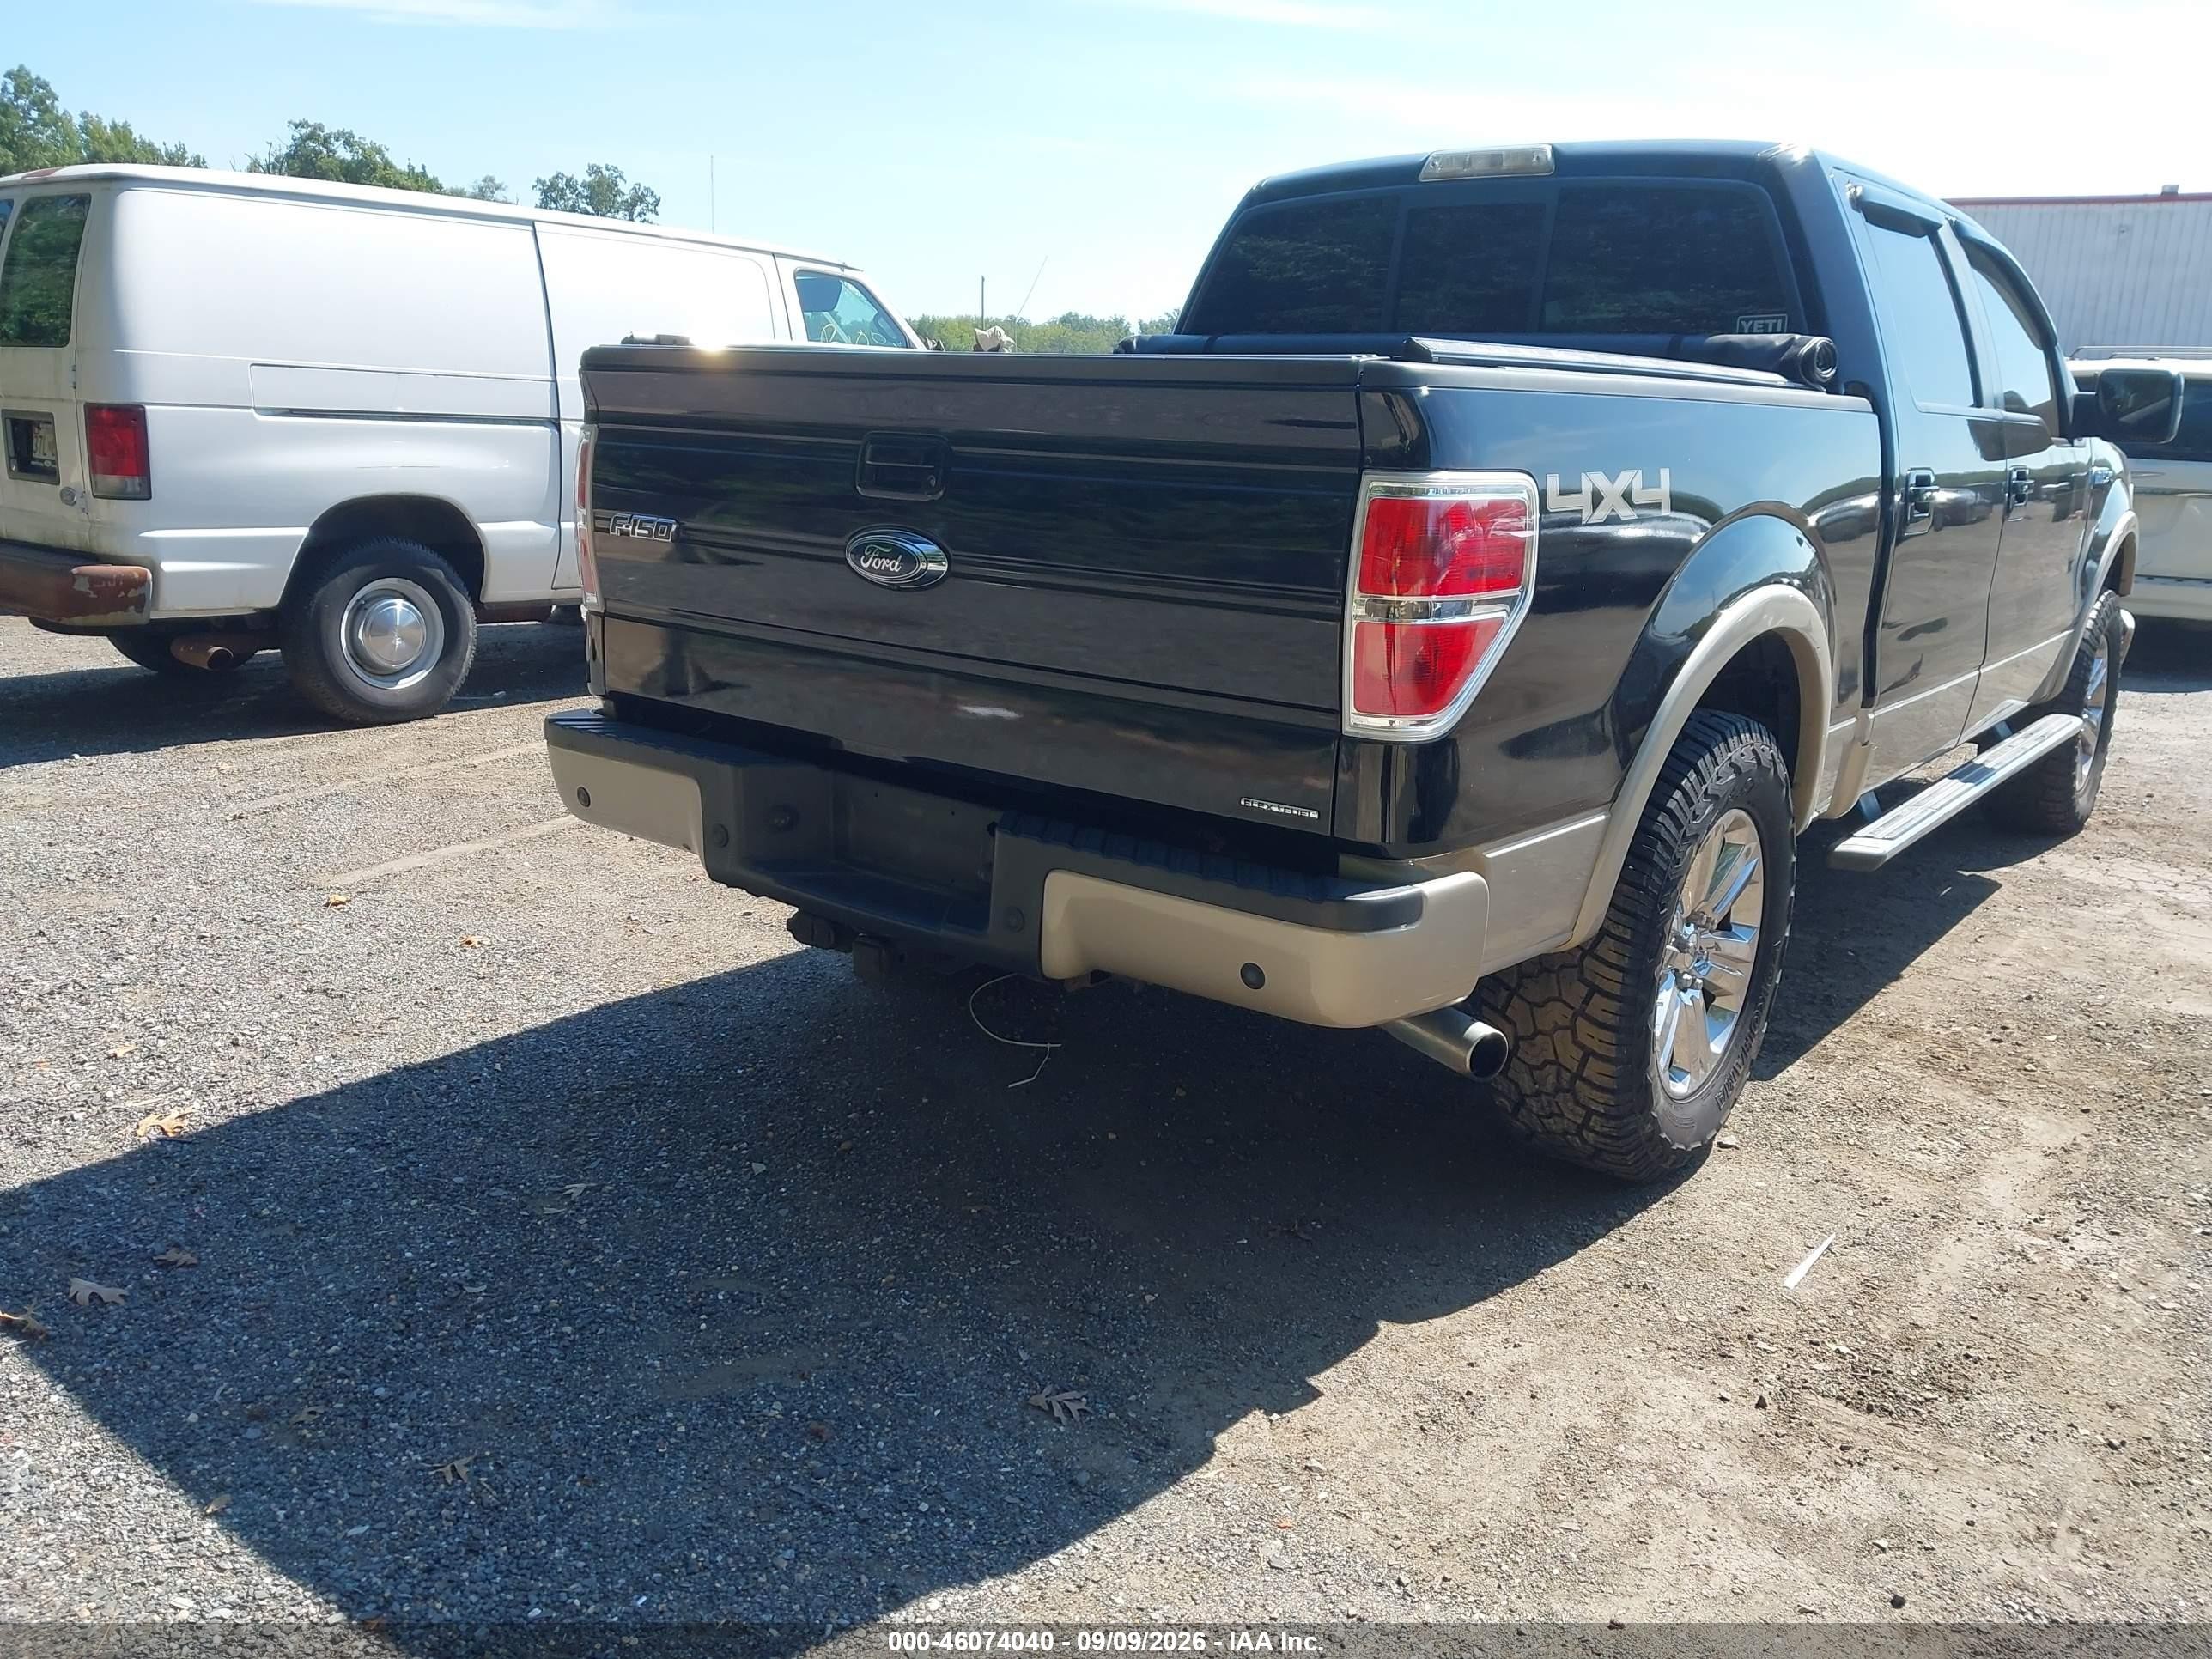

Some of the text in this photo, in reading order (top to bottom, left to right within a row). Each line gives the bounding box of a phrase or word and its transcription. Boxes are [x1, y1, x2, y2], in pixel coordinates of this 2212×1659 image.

[1741, 319, 1783, 333] YETI
[1547, 467, 1671, 525] 4X4
[610, 514, 675, 543] F-150
[860, 544, 902, 572] Ford
